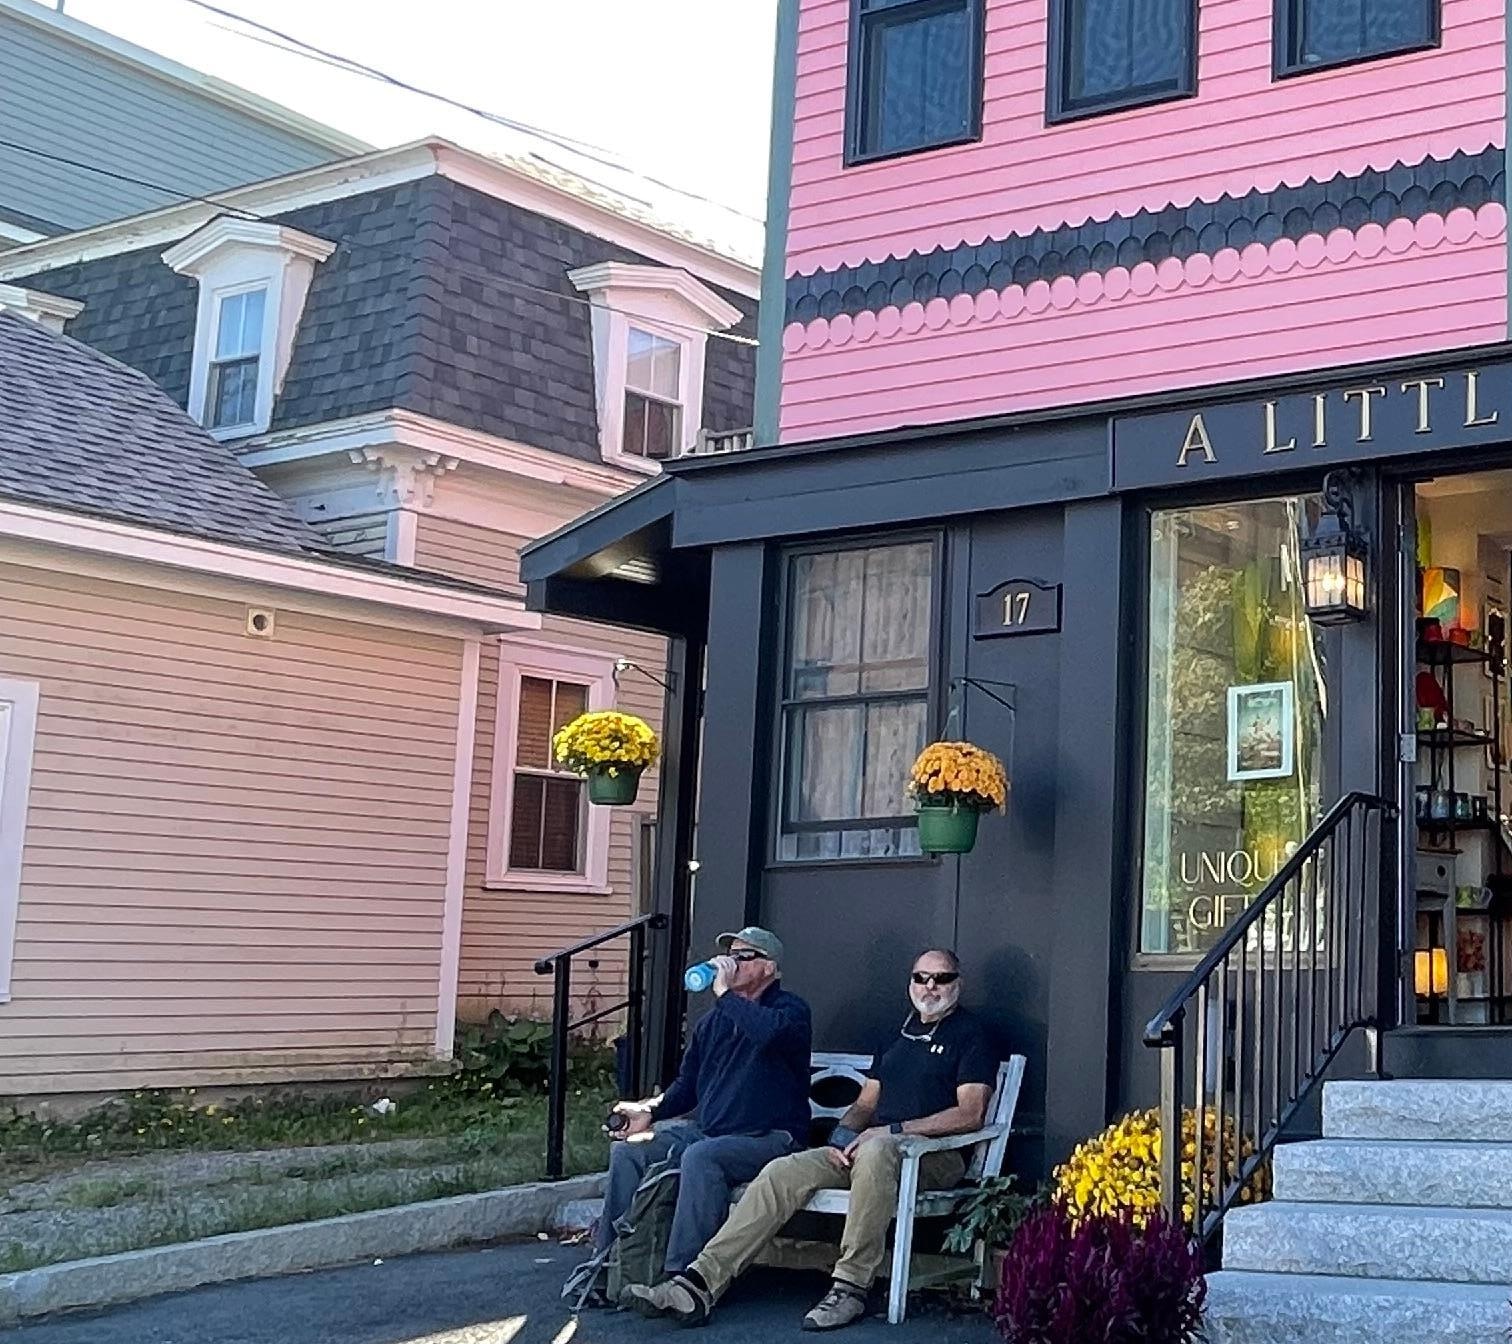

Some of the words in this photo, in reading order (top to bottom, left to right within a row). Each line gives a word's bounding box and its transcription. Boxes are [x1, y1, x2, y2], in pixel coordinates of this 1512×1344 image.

[1175, 413, 1218, 467] A
[1002, 591, 1031, 626] 17
[1188, 894, 1262, 929] GIFT
